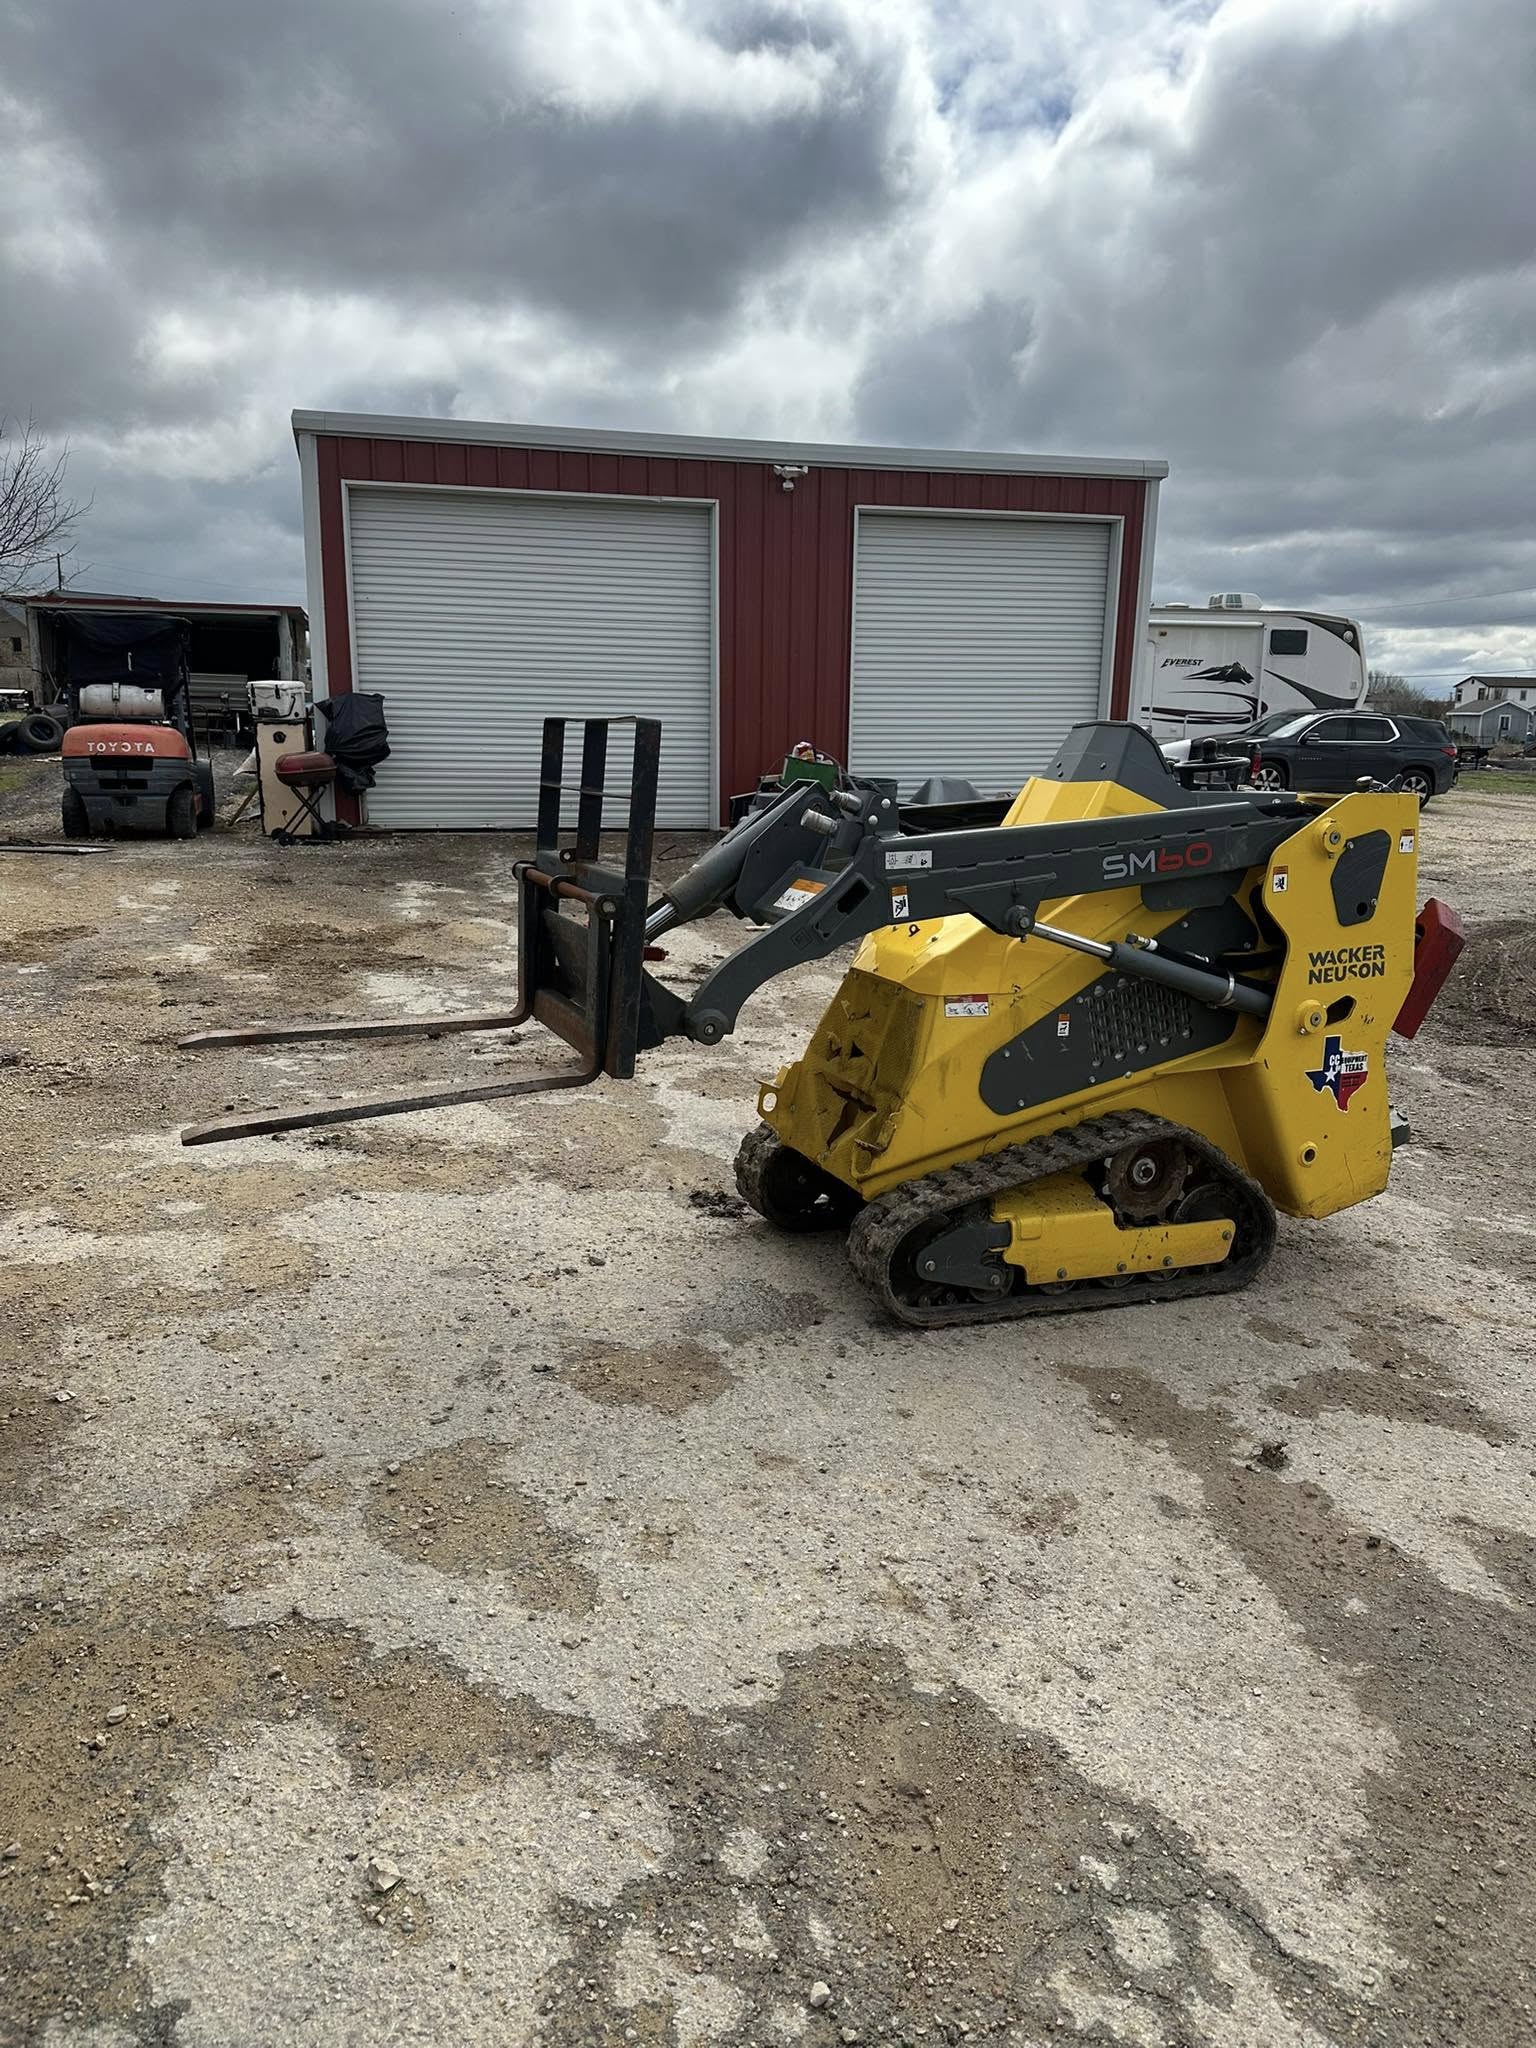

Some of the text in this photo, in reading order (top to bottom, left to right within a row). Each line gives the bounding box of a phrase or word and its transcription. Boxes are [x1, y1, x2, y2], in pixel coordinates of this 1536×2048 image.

[1160, 658, 1204, 668] EVEREST
[87, 742, 155, 753] TOYOTA
[1102, 842, 1213, 880] SM60
[1308, 944, 1385, 967] WACKER
[1308, 961, 1385, 985] NEUSON
[1329, 1054, 1341, 1066] CC
[1345, 1063, 1363, 1072] TEXAS
